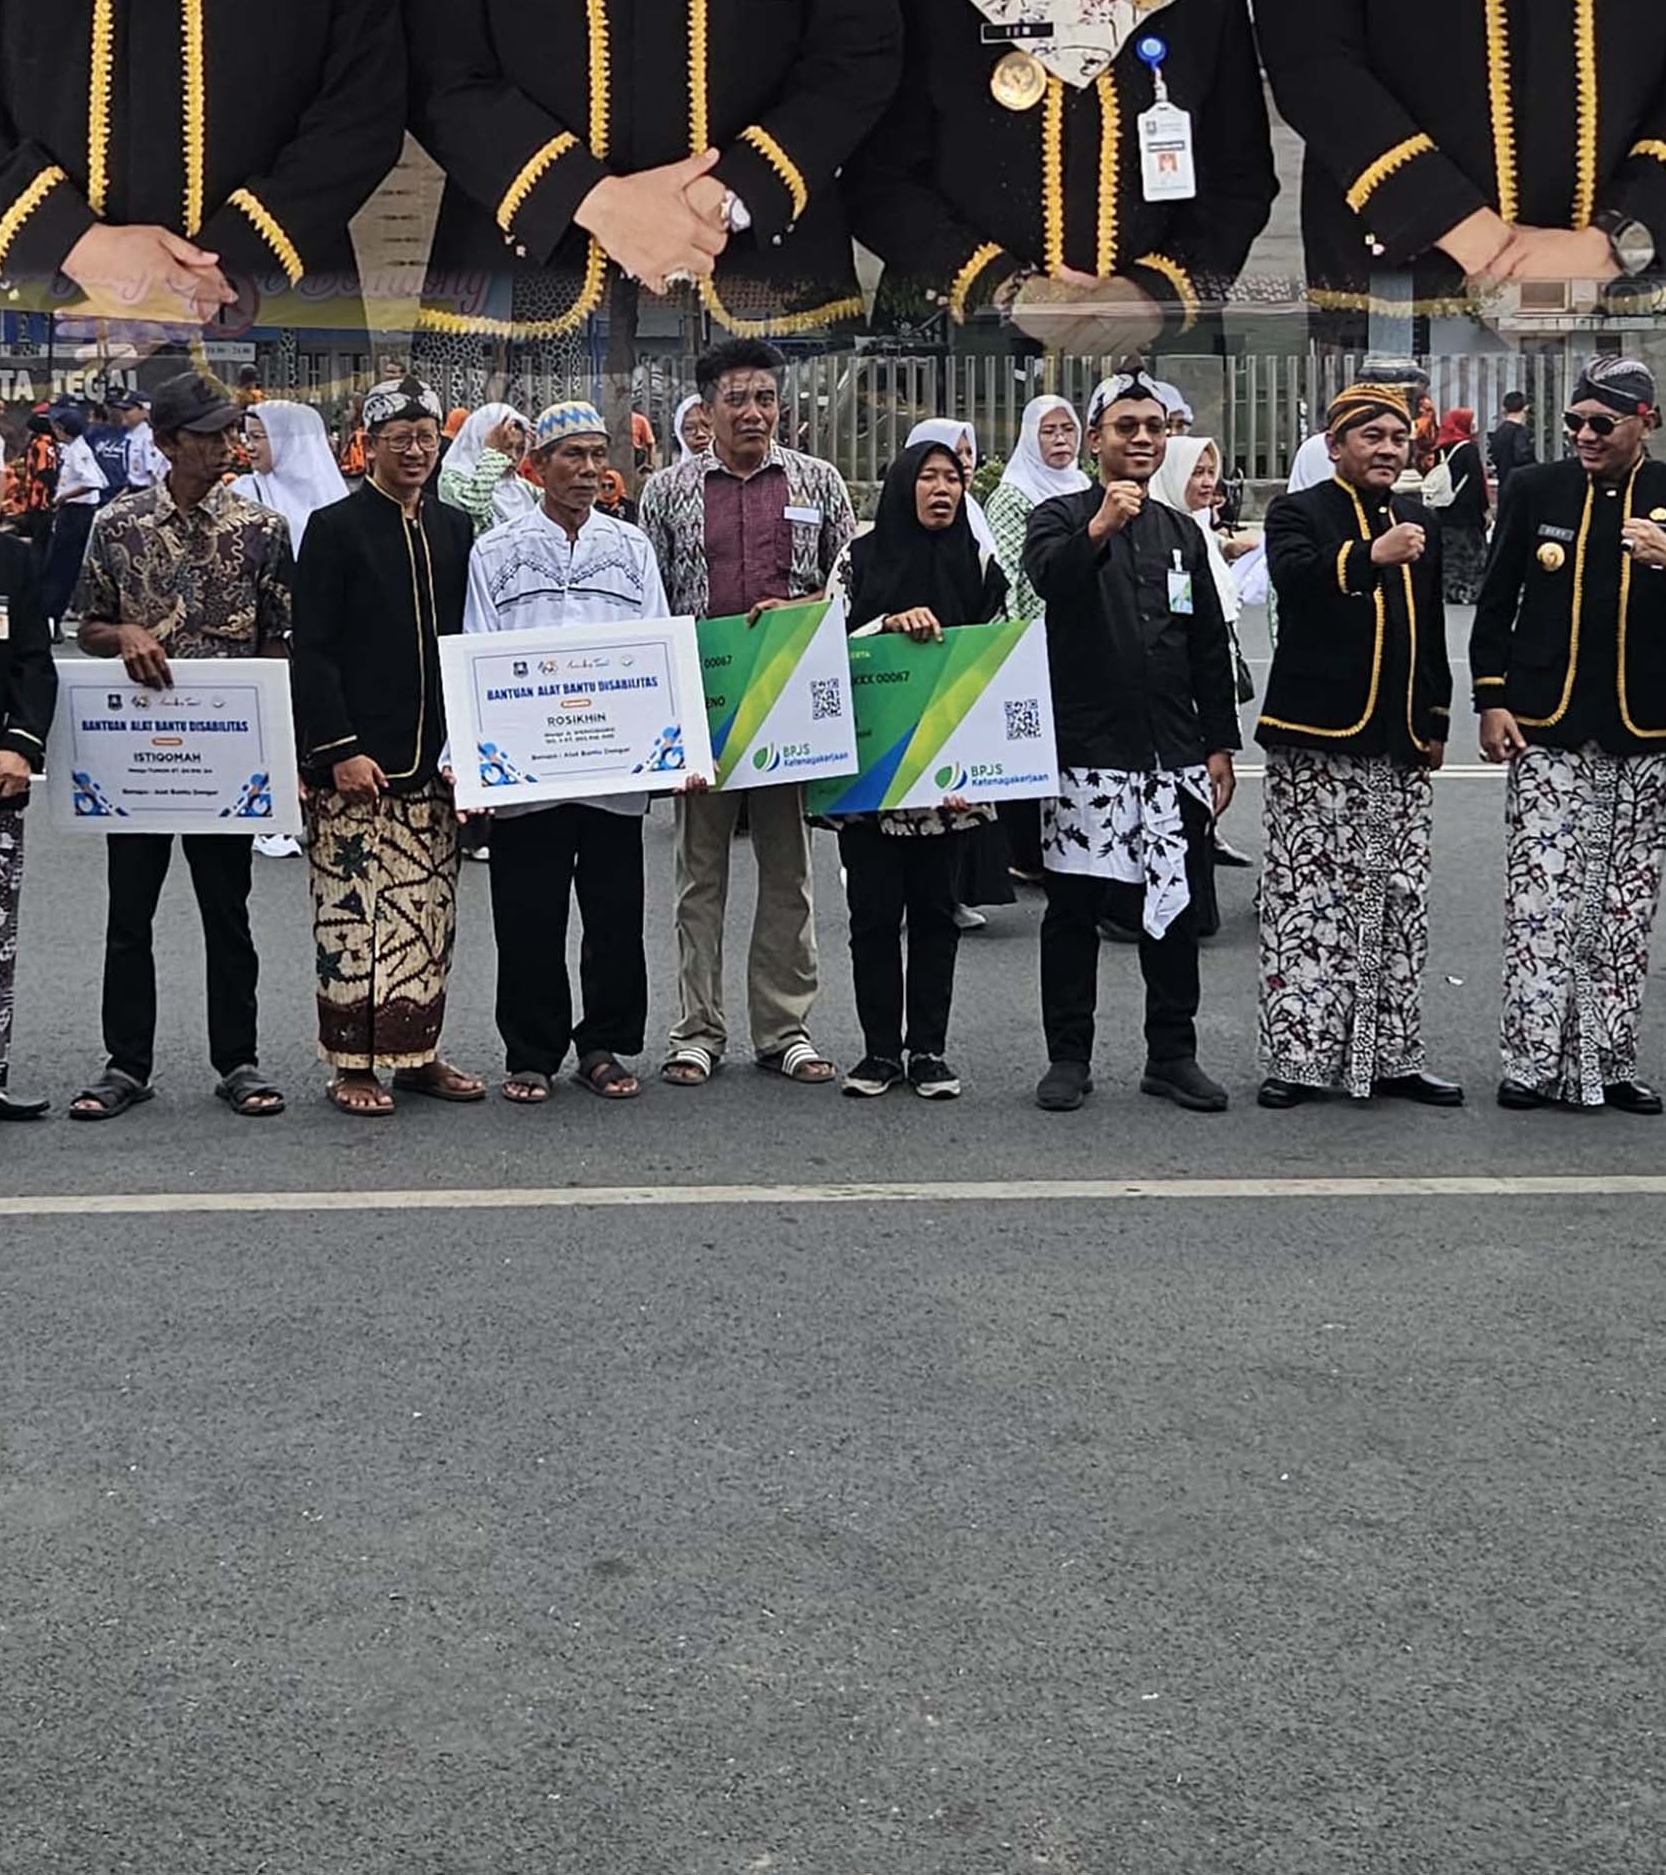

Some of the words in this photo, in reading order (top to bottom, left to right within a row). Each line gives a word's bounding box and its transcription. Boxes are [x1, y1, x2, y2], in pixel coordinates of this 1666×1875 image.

[487, 687, 534, 701] BANTUAN
[537, 684, 562, 697] ALAT
[563, 681, 596, 695] BANTU
[598, 676, 658, 692] DISABILITAS
[189, 721, 249, 733] DISABILITAS
[134, 752, 201, 763] ISTIQOMAH
[783, 743, 811, 758] BPJS
[971, 764, 1003, 777] BPJS
[971, 773, 1049, 788] Ketenagakerjaan
